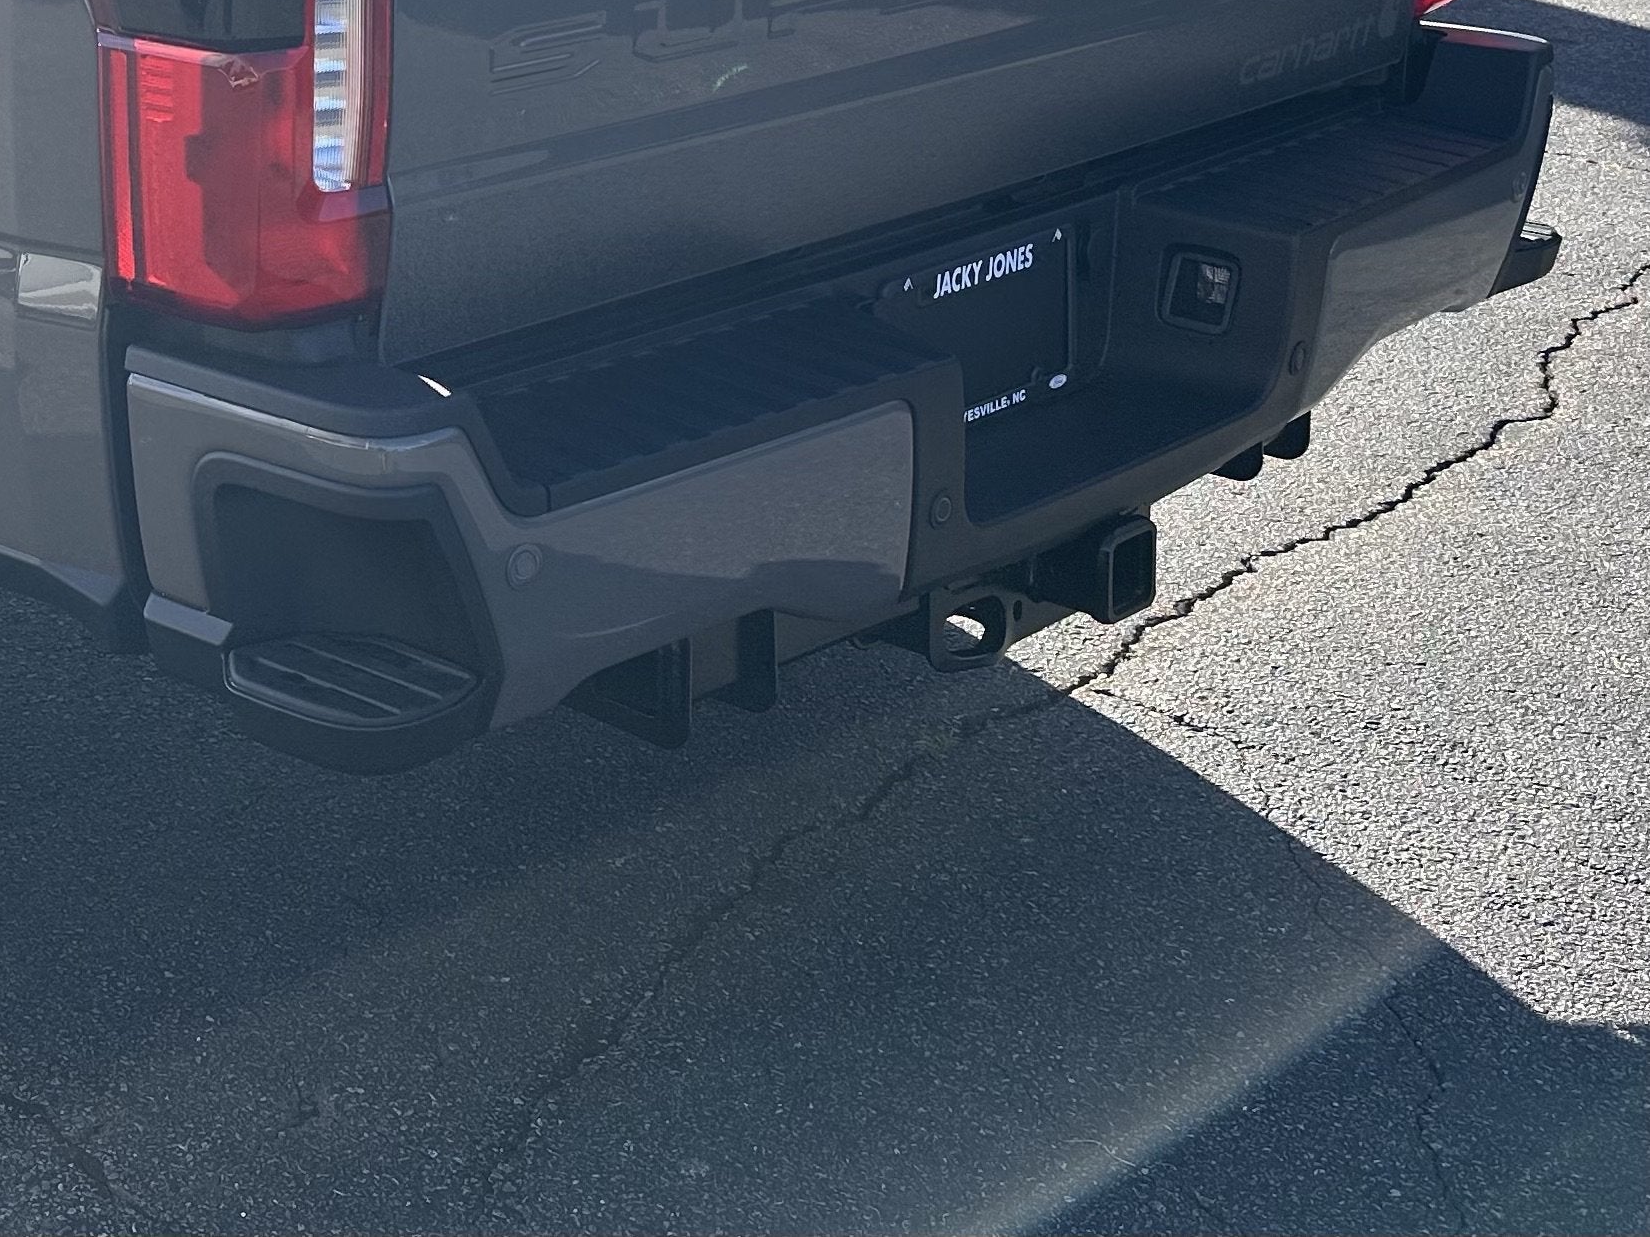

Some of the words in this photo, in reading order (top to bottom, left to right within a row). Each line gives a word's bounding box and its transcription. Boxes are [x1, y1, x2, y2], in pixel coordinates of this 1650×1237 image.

[1238, 13, 1377, 86] carhartt
[932, 259, 983, 300] JACKY
[985, 242, 1035, 282] JONES
[1012, 389, 1027, 404] NC
